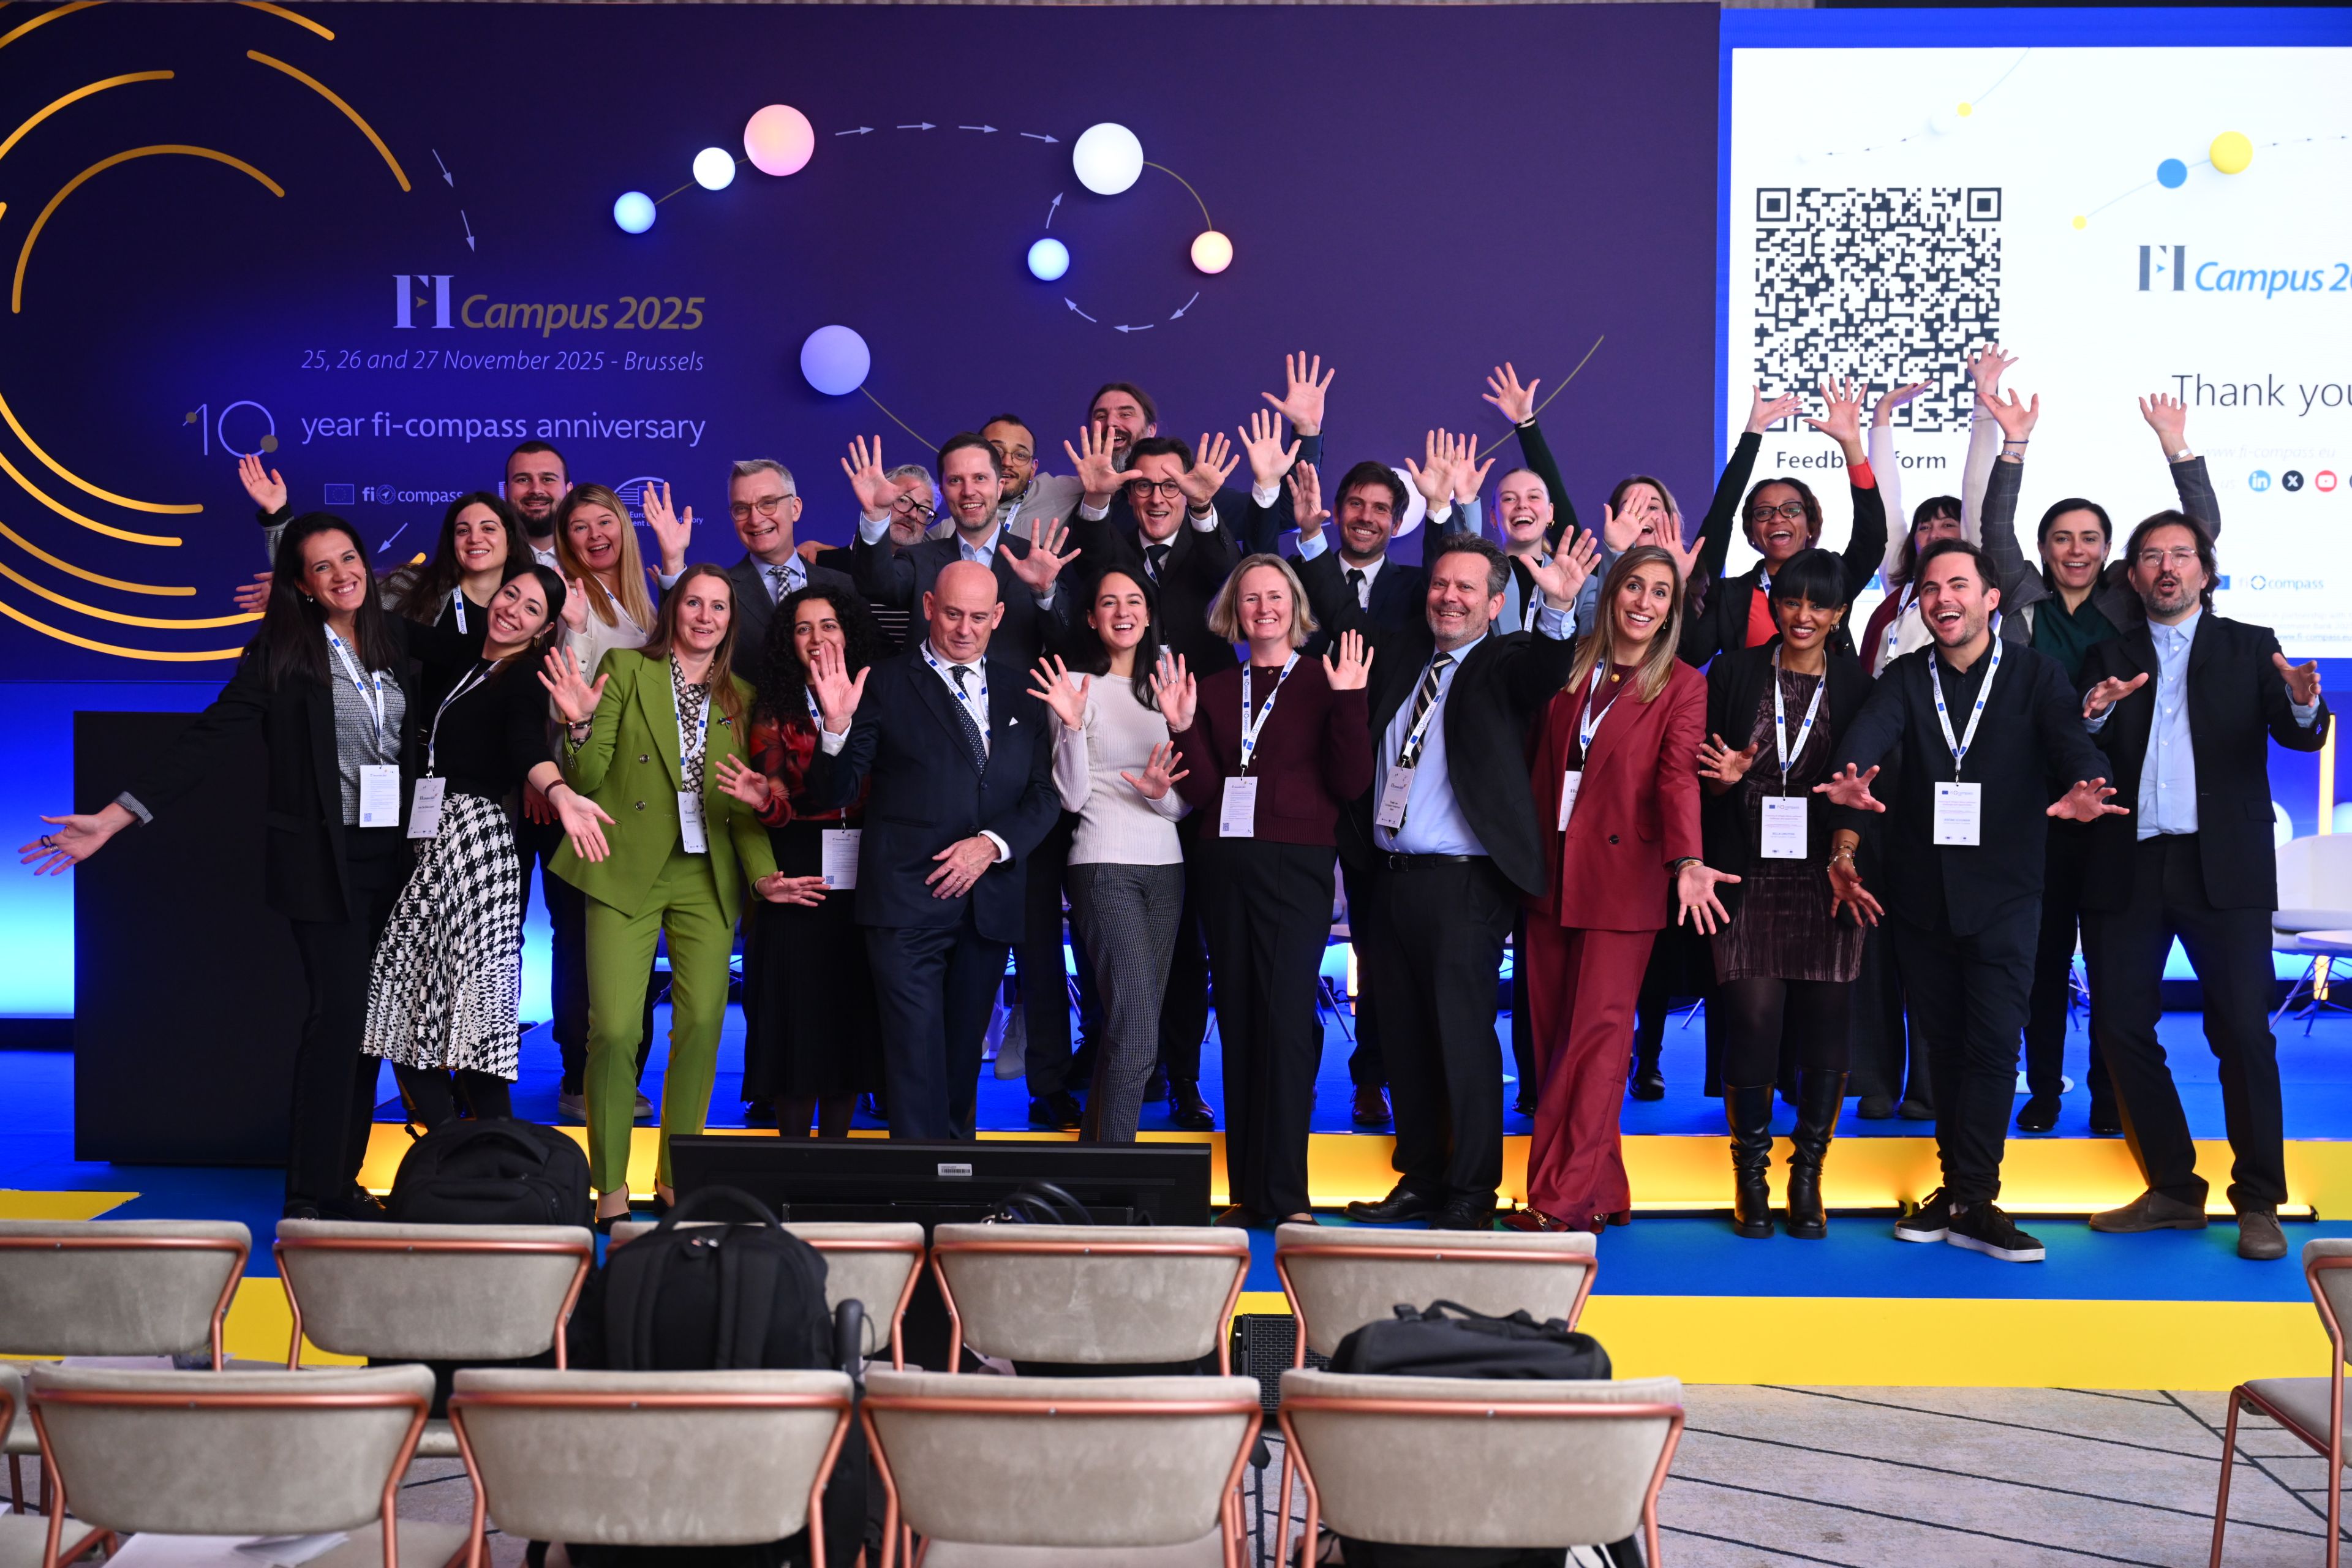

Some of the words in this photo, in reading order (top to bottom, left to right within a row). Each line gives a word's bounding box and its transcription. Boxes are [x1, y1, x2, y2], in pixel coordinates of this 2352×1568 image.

[2195, 262, 2324, 300] Campus
[461, 294, 609, 338] Campus
[614, 296, 706, 330] 2025
[301, 350, 330, 371] 25,
[337, 350, 361, 369] 26
[368, 350, 407, 369] and
[413, 350, 437, 369] 27
[444, 350, 550, 369] November
[555, 351, 605, 370] 2025
[625, 351, 704, 371] Brussels
[2171, 373, 2285, 407] Thank
[2298, 383, 2352, 417] yo
[301, 417, 366, 445] year
[371, 412, 527, 443] fi-compass
[537, 412, 706, 447] anniversary
[1776, 451, 1844, 469] Feedb
[362, 487, 375, 502] fi
[2268, 579, 2324, 591] compass
[938, 667, 951, 684] compass
[966, 701, 979, 720] compass
[1257, 712, 1267, 729] compass
